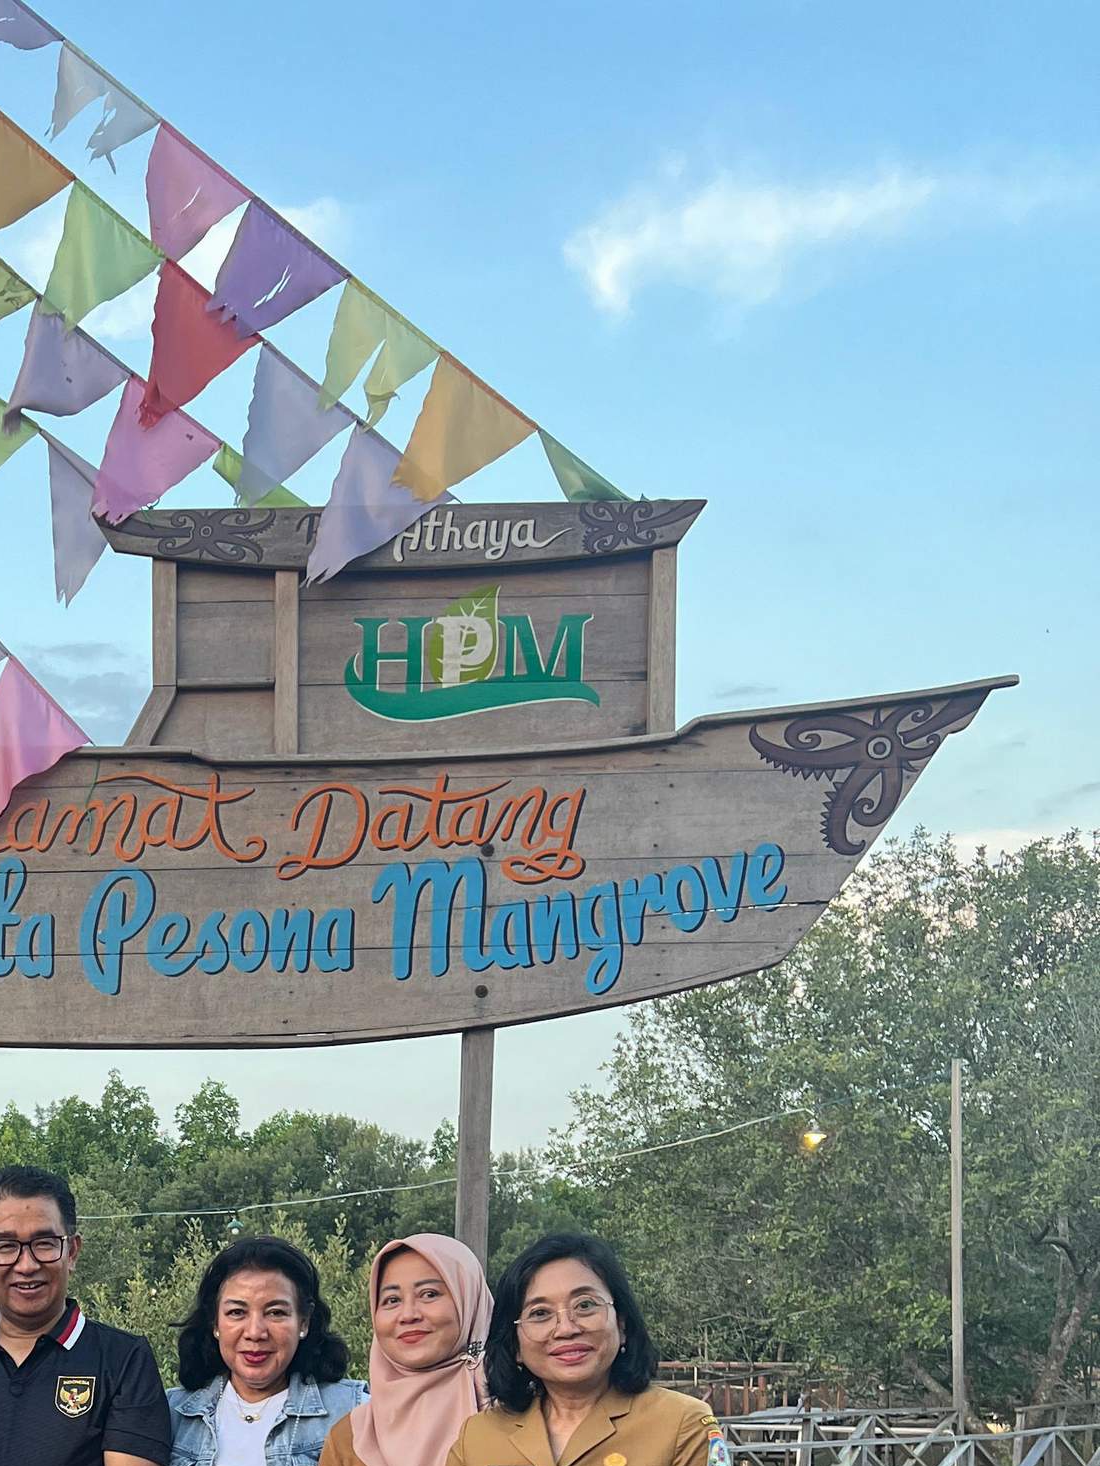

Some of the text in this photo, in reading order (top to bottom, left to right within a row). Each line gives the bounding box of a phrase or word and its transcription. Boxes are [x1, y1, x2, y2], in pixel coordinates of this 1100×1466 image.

[352, 612, 594, 693] HPM
[275, 774, 586, 883] Datang
[79, 868, 354, 995] Pesona
[372, 843, 788, 995] Mangrove
